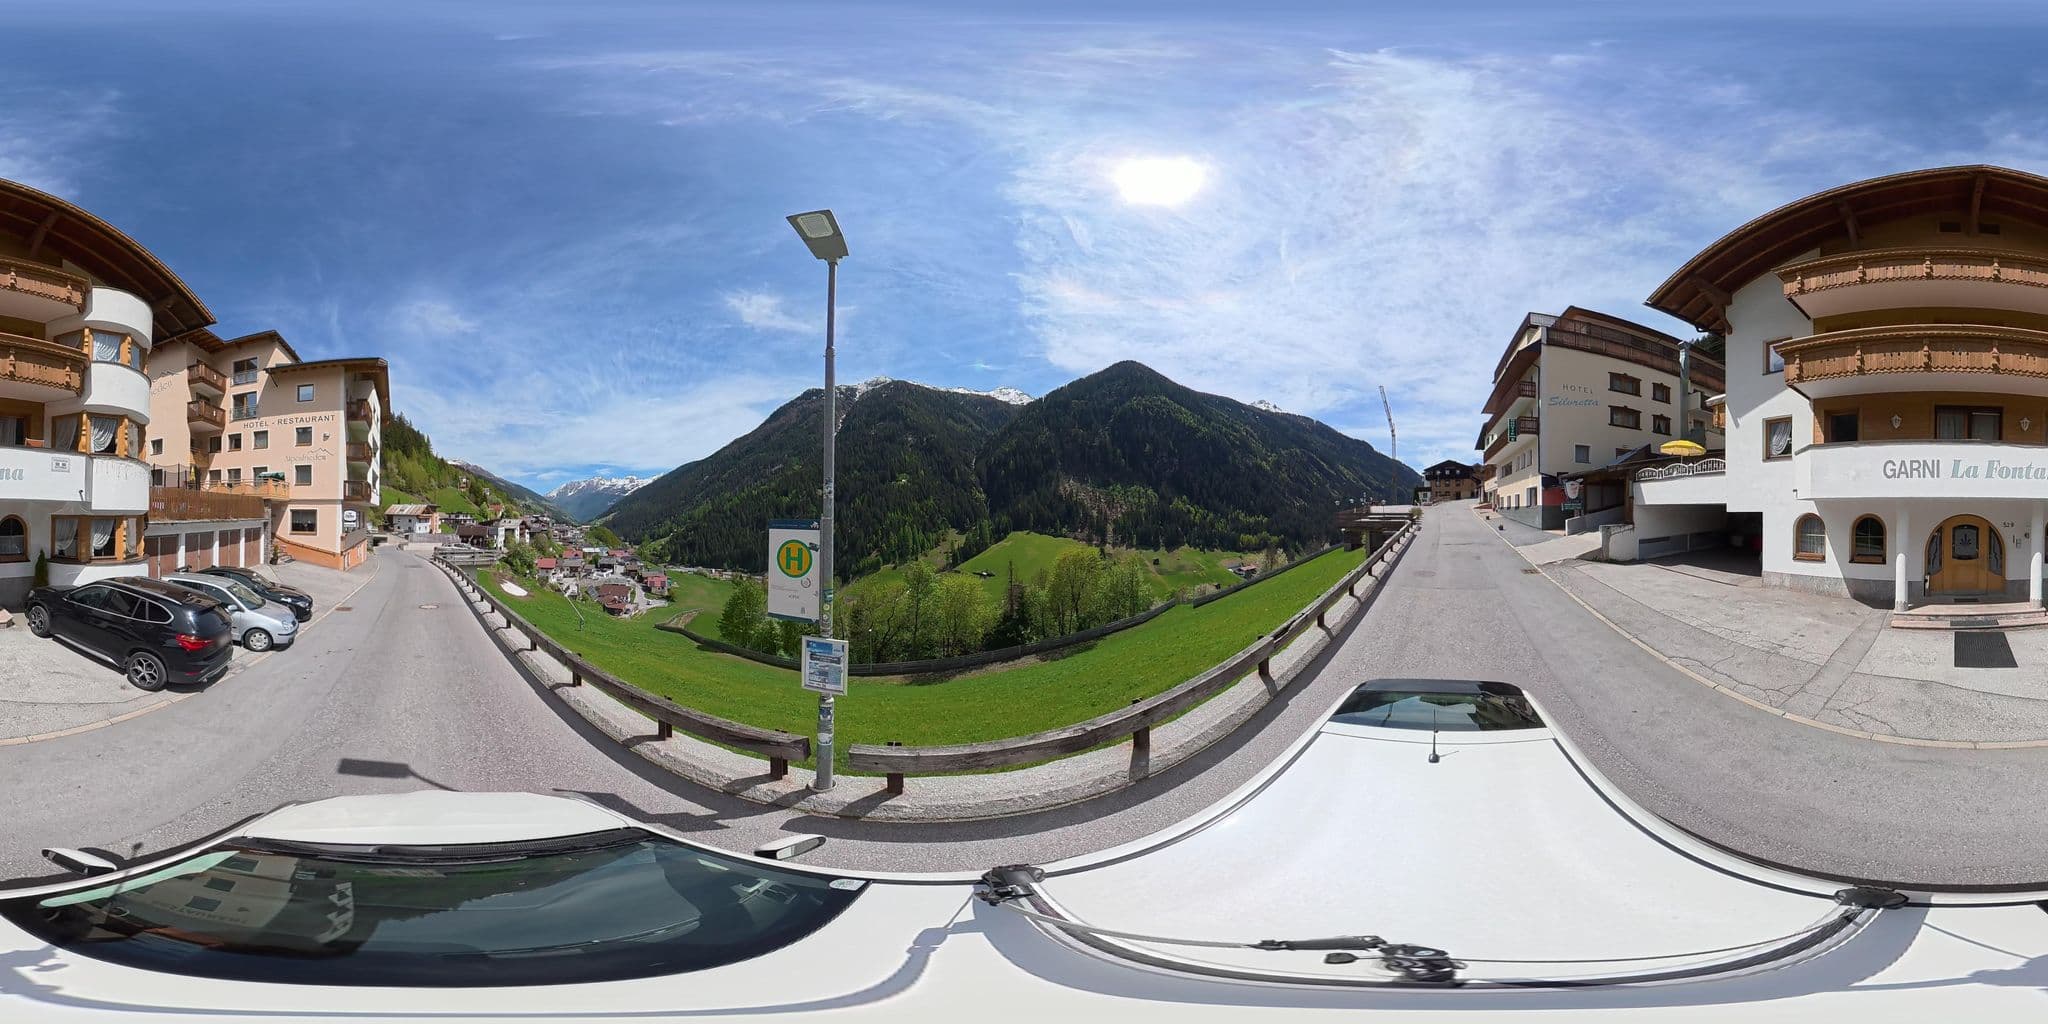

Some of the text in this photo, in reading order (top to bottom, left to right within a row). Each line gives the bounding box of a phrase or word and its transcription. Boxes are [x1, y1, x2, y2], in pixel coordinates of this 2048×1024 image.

[1562, 383, 1593, 394] HOTEL
[243, 419, 269, 429] HOTEL
[277, 414, 335, 425] RESTAURANT
[1883, 459, 2048, 480] GARNI La Fonta
[786, 546, 803, 571] H
